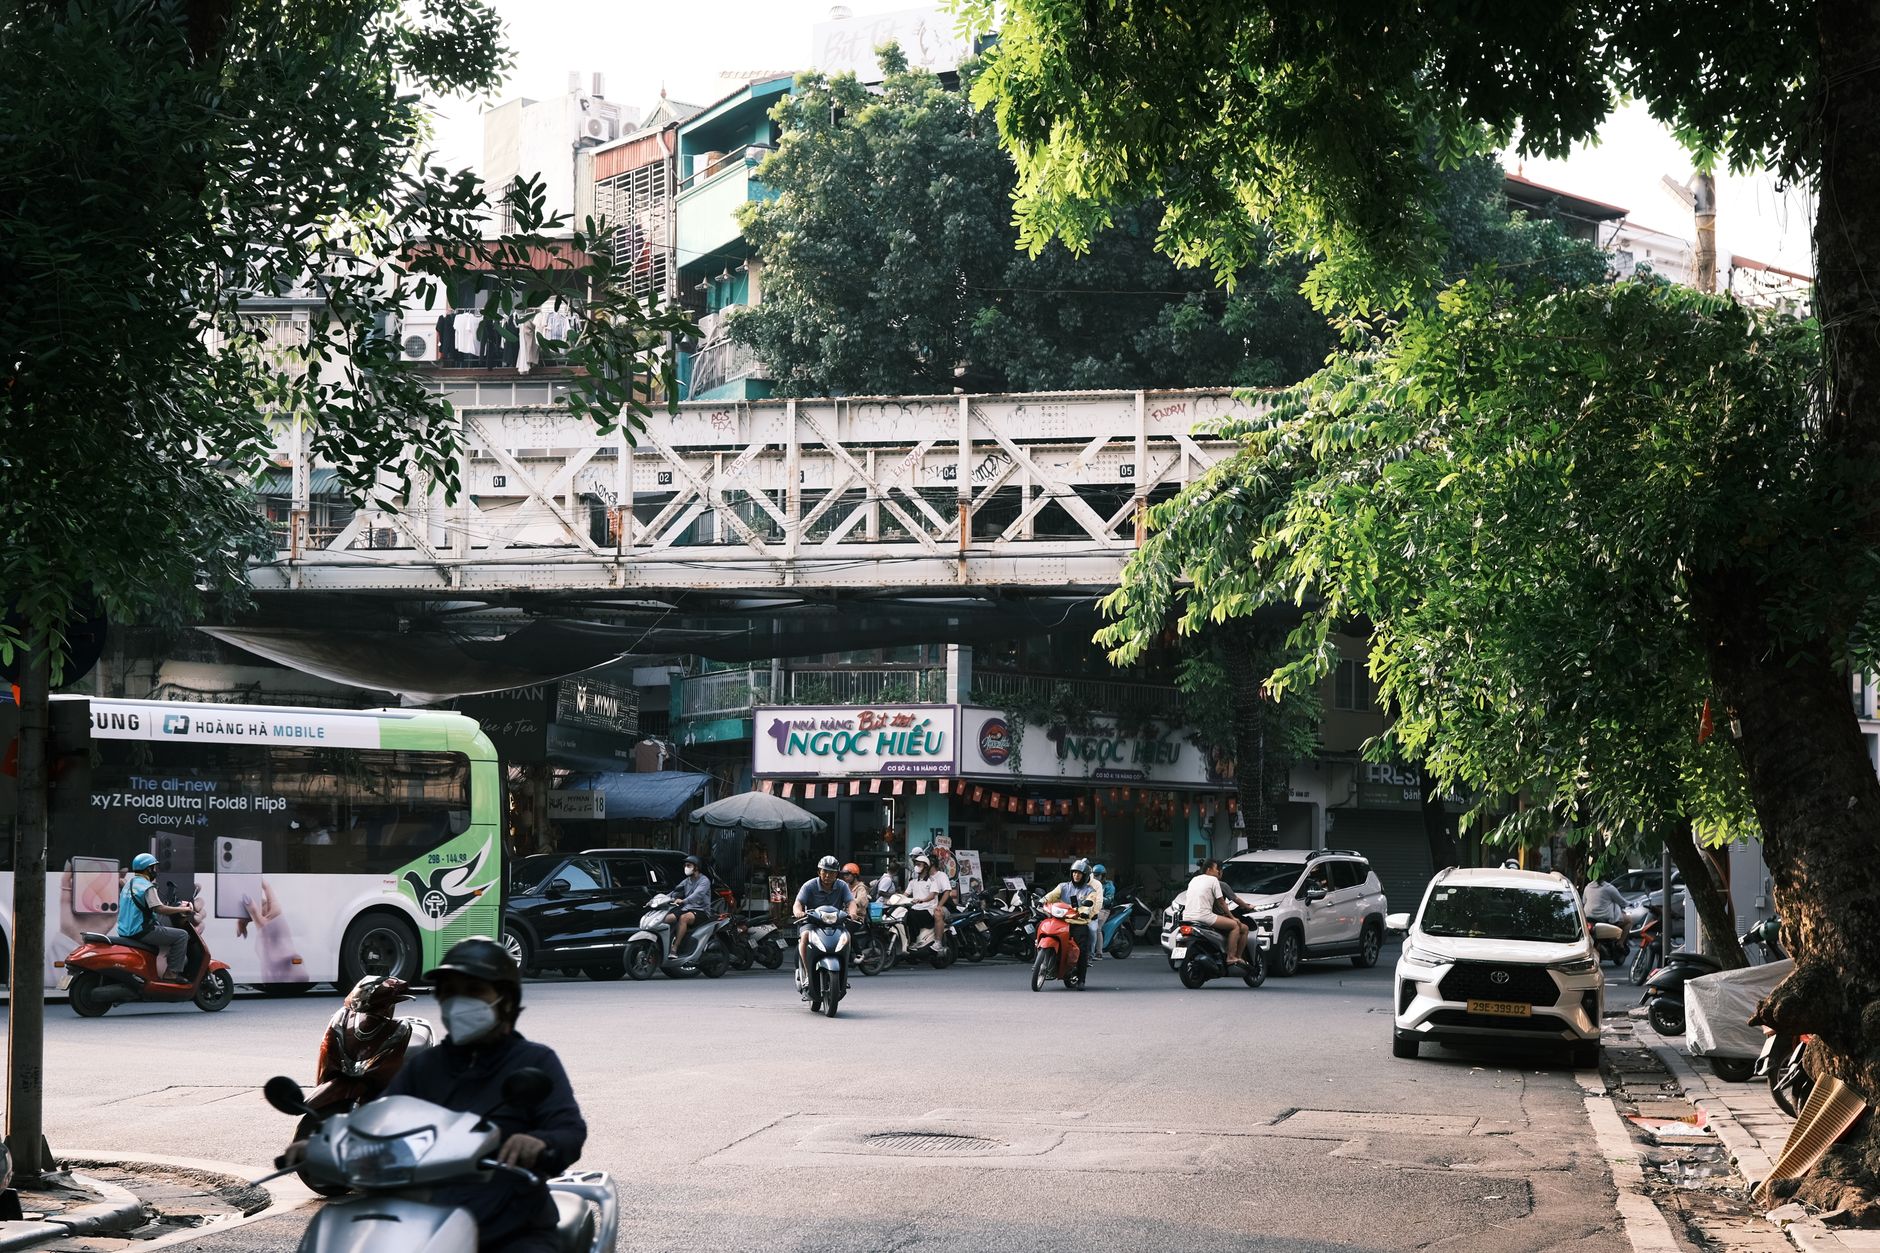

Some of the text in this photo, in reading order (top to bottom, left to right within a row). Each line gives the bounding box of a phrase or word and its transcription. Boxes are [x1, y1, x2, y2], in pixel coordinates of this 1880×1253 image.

[943, 467, 956, 478] 04
[1121, 466, 1132, 475] 05
[494, 477, 504, 486] 01
[659, 473, 670, 483] 02
[594, 694, 618, 718] MYMAN
[196, 719, 325, 738] HOÀNG HÀ MOBILE
[788, 718, 943, 761] NGỌC HIẾU
[1062, 737, 1126, 768] NGỌC
[920, 764, 938, 772] HÀNG
[130, 777, 217, 792] The all-new
[112, 794, 121, 806] Z
[124, 794, 164, 807] Fold8
[167, 795, 201, 809] Ultra
[209, 797, 247, 810] Fold8
[255, 798, 286, 813] Flip8
[595, 797, 604, 812] 18
[138, 814, 195, 827] Galaxy AI
[428, 855, 440, 864] 29B
[1473, 1002, 1526, 1015] 29E-399.02
